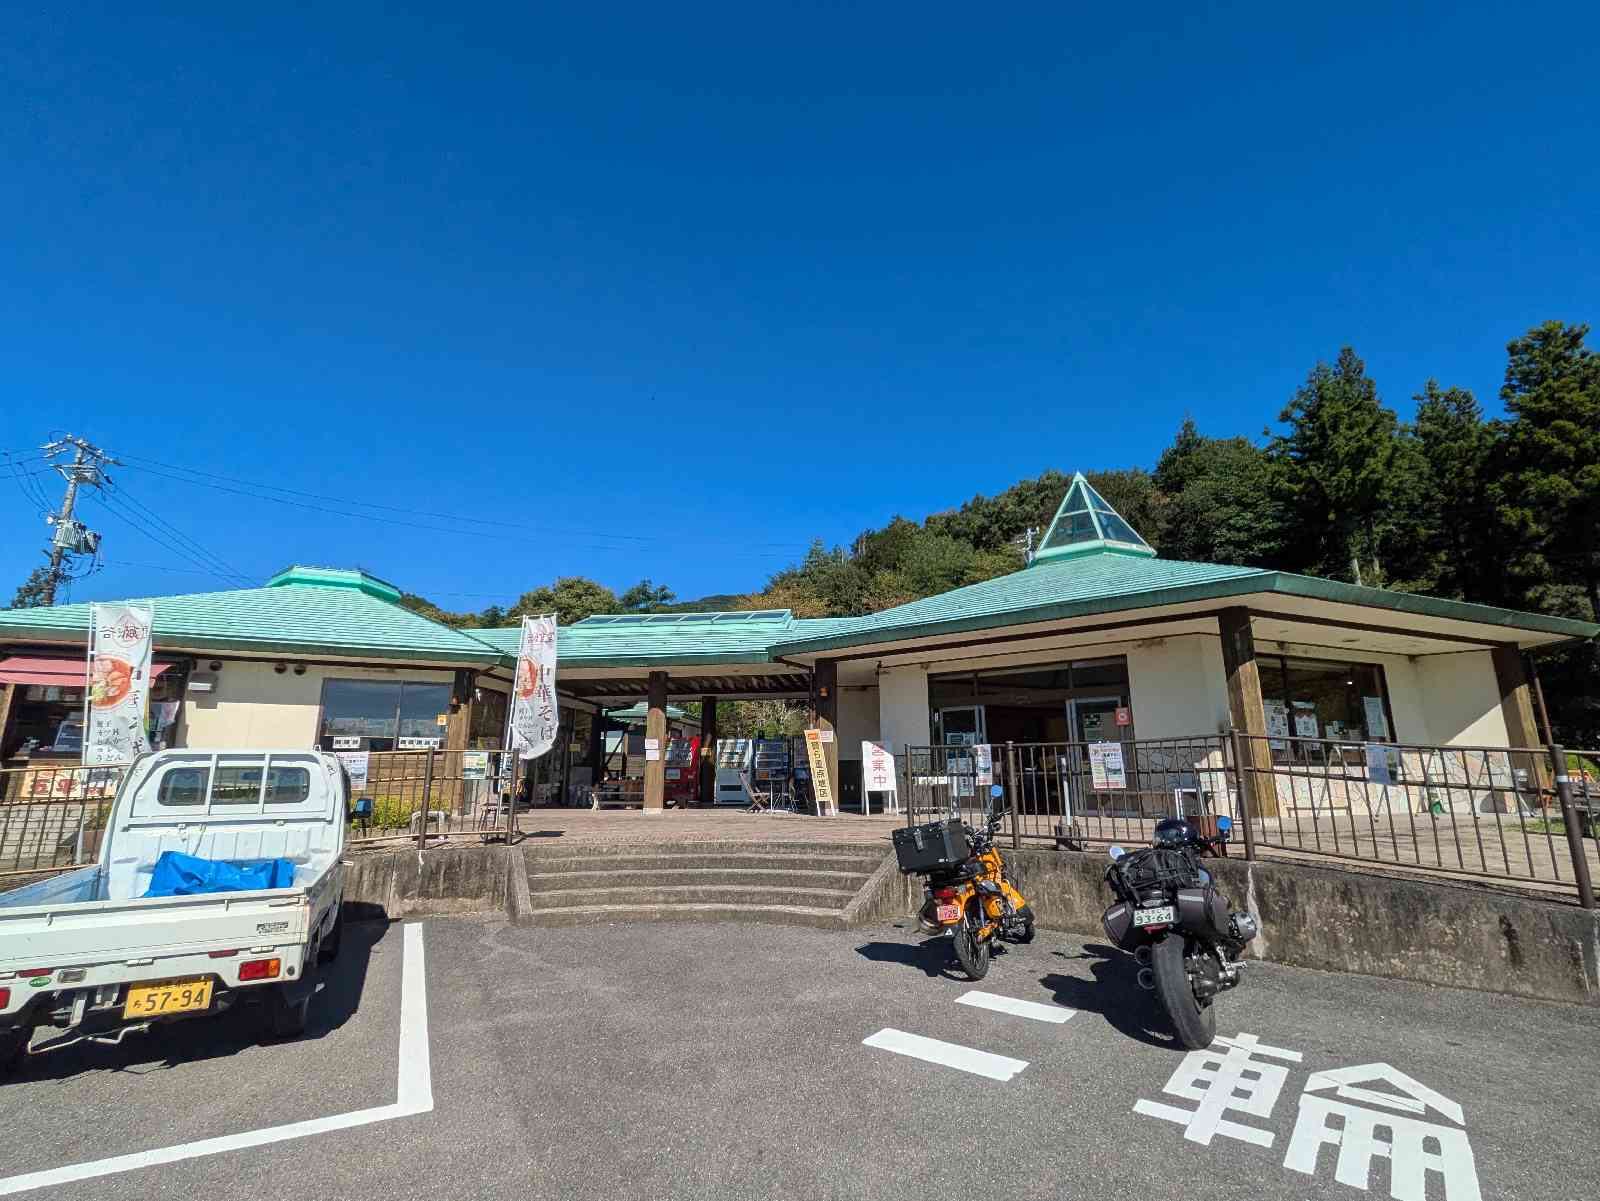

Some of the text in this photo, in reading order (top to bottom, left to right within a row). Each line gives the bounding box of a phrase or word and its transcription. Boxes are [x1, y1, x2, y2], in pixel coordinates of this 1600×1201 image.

[871, 744, 887, 788] 営業中
[144, 988, 204, 1011] 57-94
